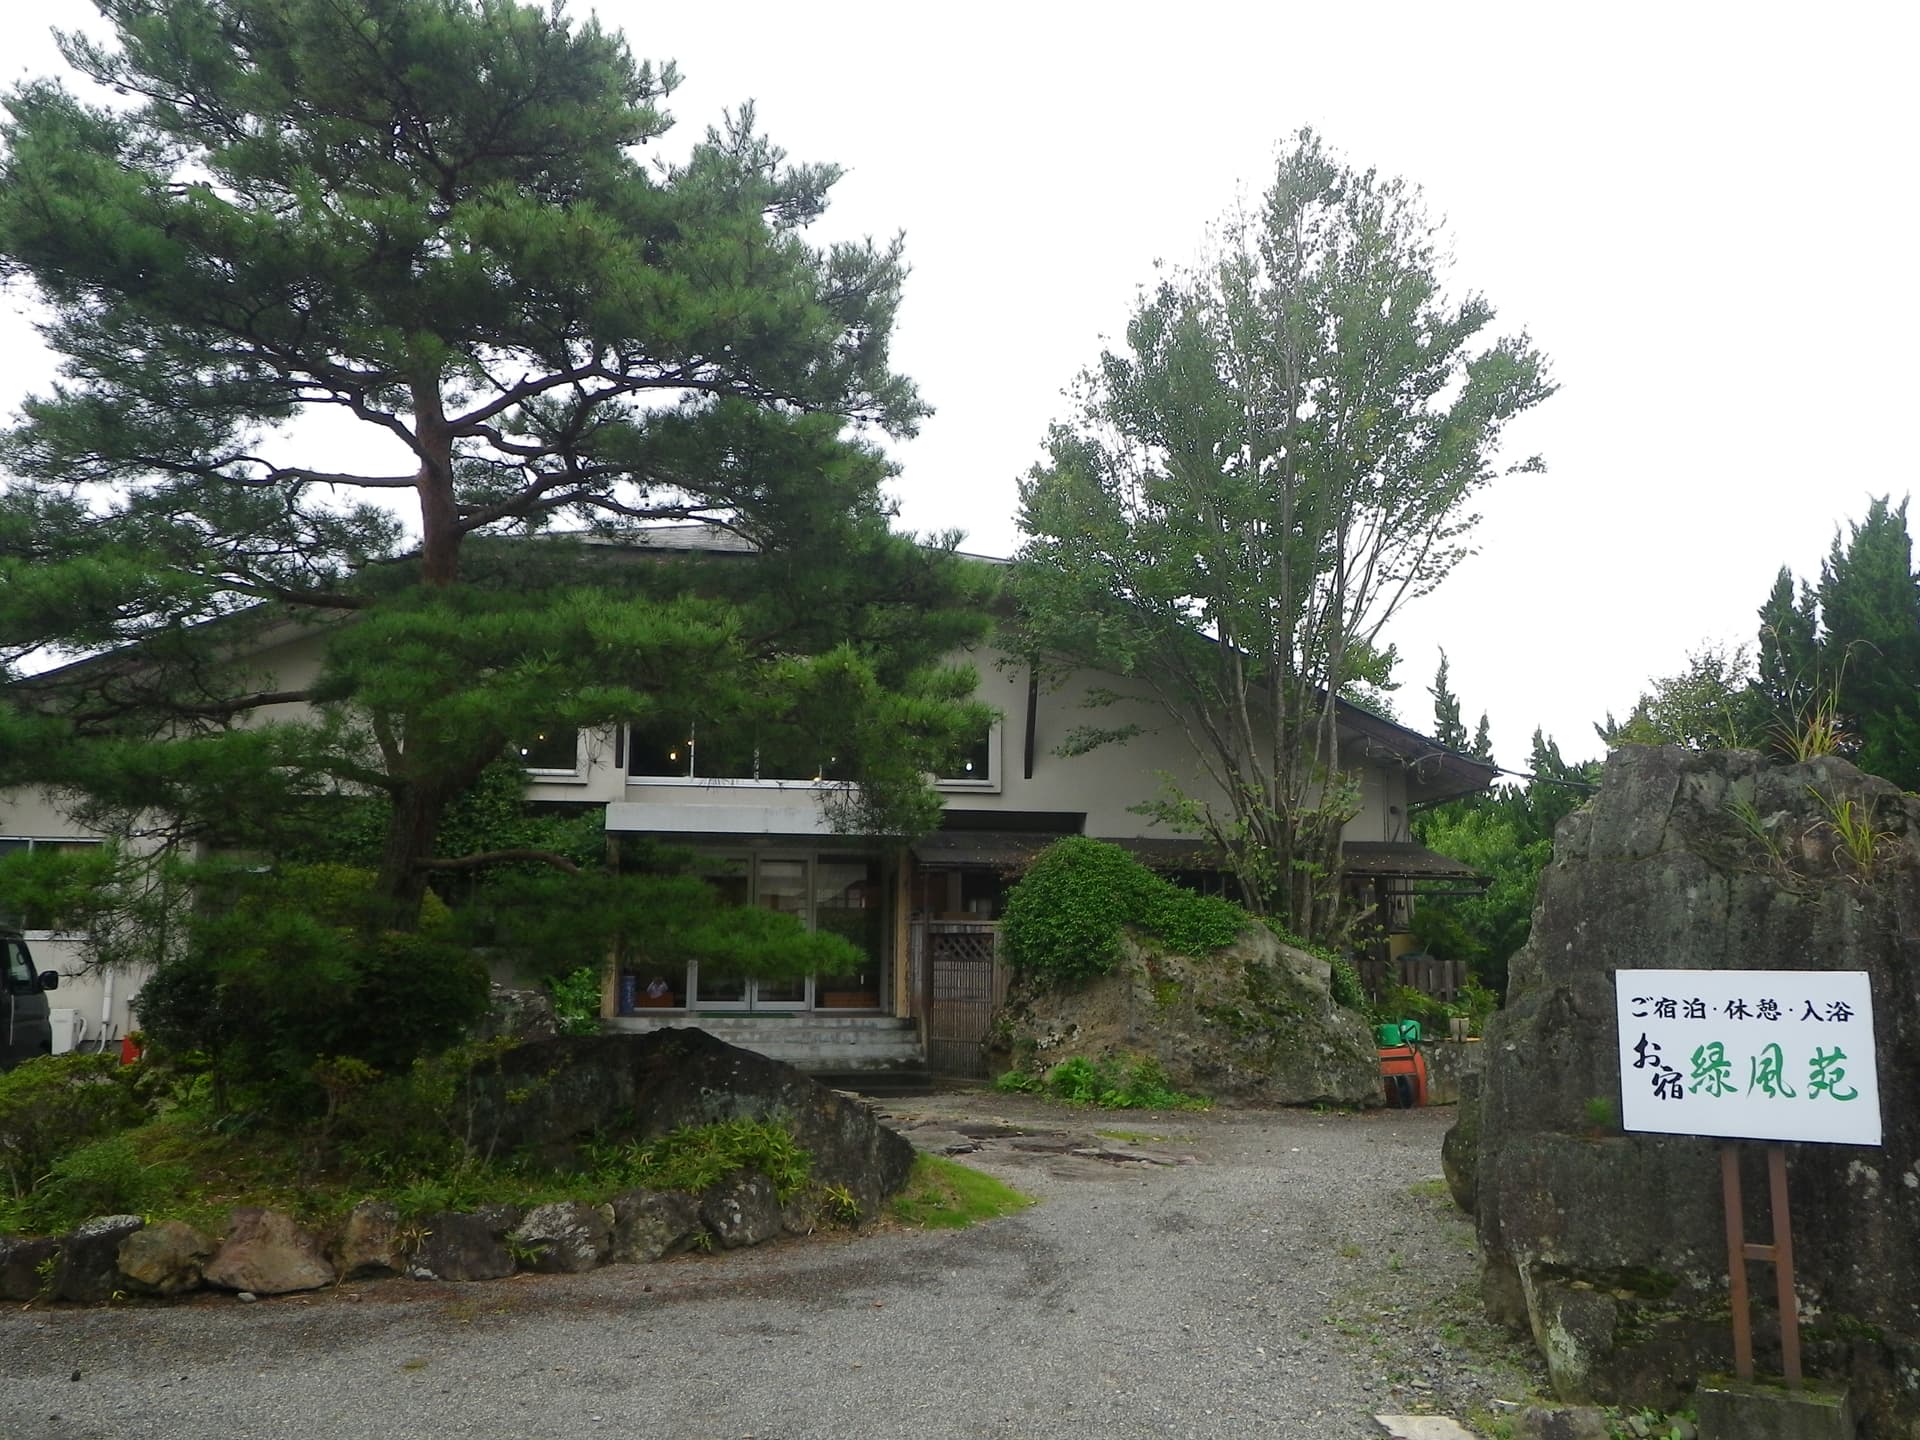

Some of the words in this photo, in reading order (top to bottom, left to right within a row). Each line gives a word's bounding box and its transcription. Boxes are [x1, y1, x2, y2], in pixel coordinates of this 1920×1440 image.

[1632, 1032, 1684, 1101] お宿
[1688, 1040, 1859, 1102] 緑風苑
